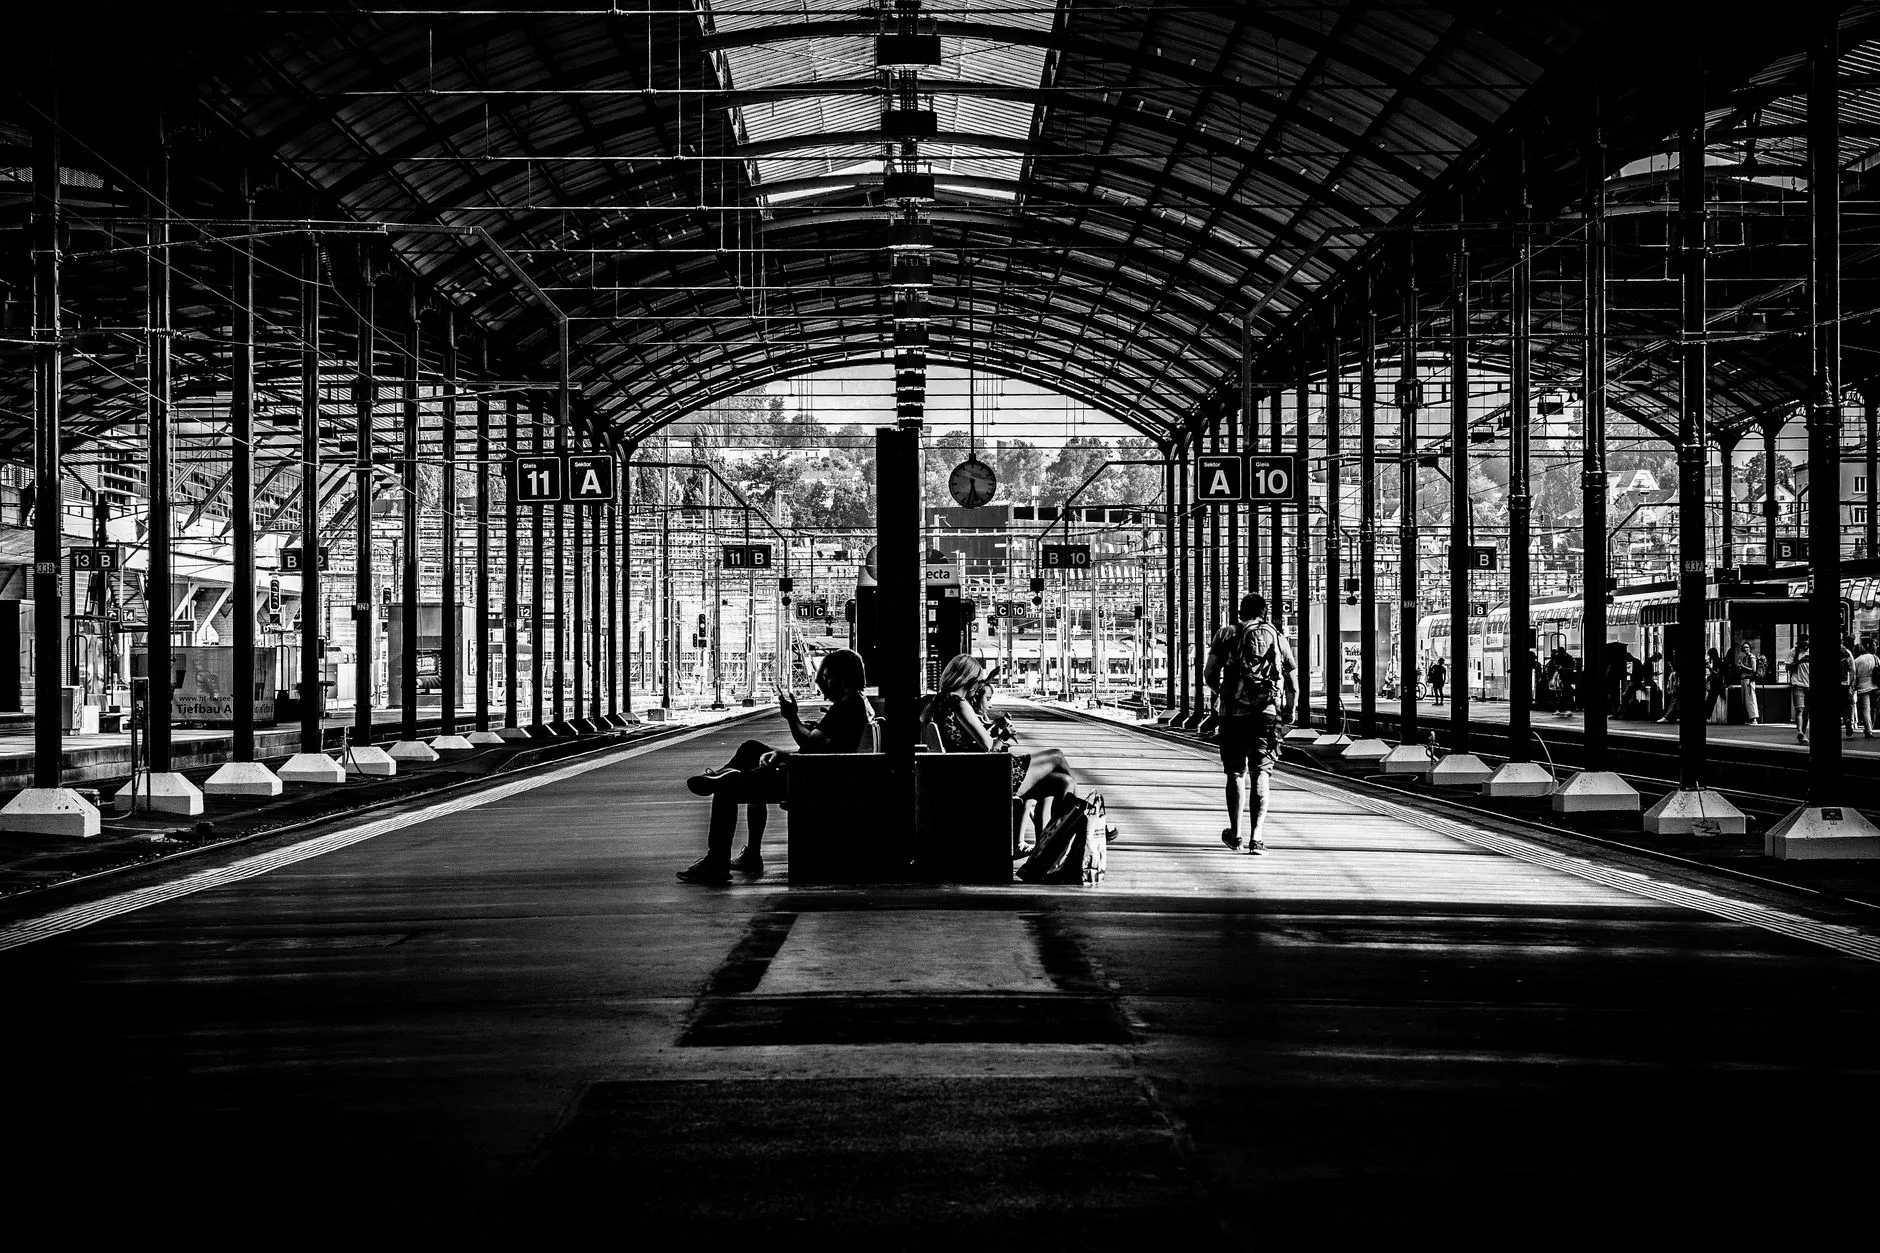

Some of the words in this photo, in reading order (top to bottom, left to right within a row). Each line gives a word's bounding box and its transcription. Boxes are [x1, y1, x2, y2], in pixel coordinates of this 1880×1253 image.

[527, 470, 550, 496] 11
[580, 469, 602, 495] A
[1208, 469, 1231, 495] A
[1255, 469, 1288, 495] 10
[1781, 545, 1792, 558] B
[74, 554, 90, 567] 13
[101, 554, 111, 567] B
[286, 555, 297, 568] B
[729, 552, 741, 565] 11
[754, 552, 764, 565] B
[1049, 552, 1059, 565] B
[1070, 552, 1086, 565] 10
[1479, 554, 1490, 566] B
[38, 563, 53, 573] 338
[926, 569, 950, 579] ecta
[519, 609, 530, 617] 12
[800, 608, 808, 616] 11
[816, 607, 824, 616] C
[999, 607, 1007, 616] C
[1013, 607, 1024, 615] 10
[1282, 604, 1291, 612] C
[1476, 606, 1484, 615] 8
[123, 612, 134, 620] 14
[176, 703, 221, 714] Tiefbau
